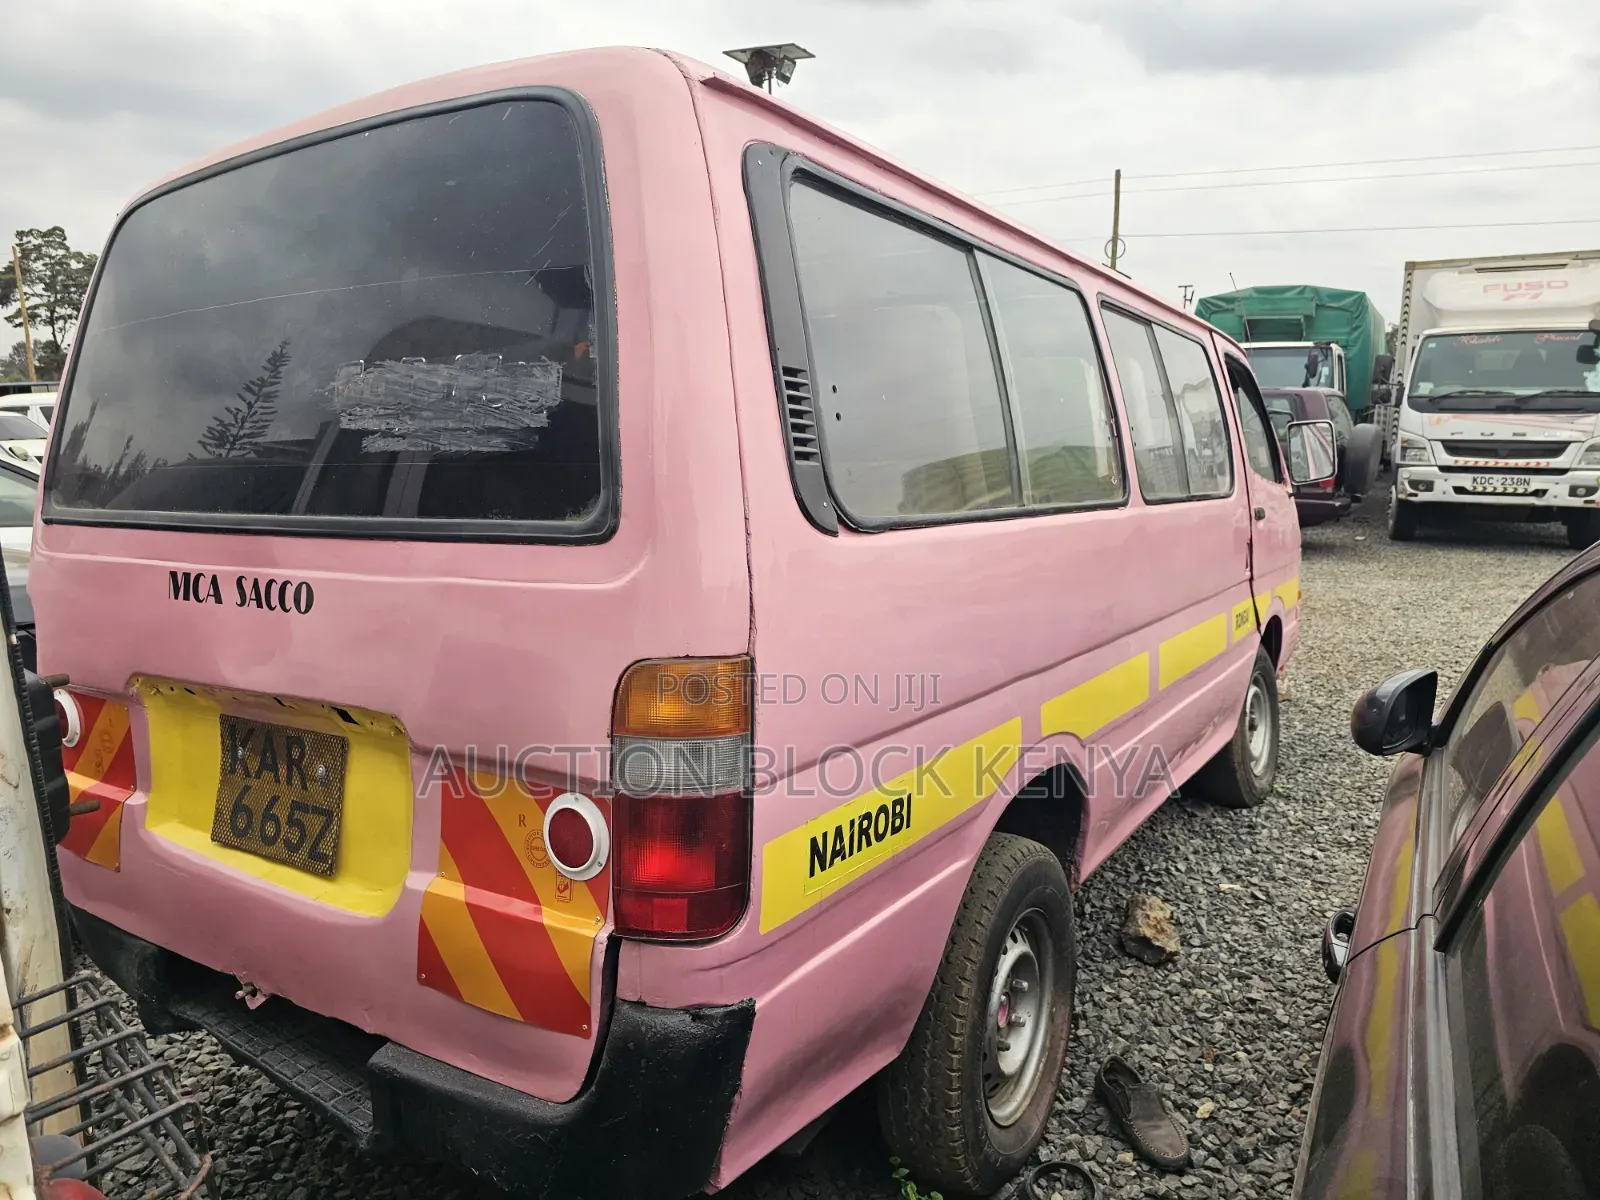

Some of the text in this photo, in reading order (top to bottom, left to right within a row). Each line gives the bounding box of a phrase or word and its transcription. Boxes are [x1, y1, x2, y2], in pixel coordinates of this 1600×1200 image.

[1482, 280, 1569, 293] FUSO
[1501, 477, 1531, 487] 238N
[168, 570, 314, 615] MCA SACCO
[228, 724, 308, 792] KAR
[229, 785, 333, 861] 665Z
[517, 813, 527, 828] R
[808, 792, 912, 878] NAIROBI
